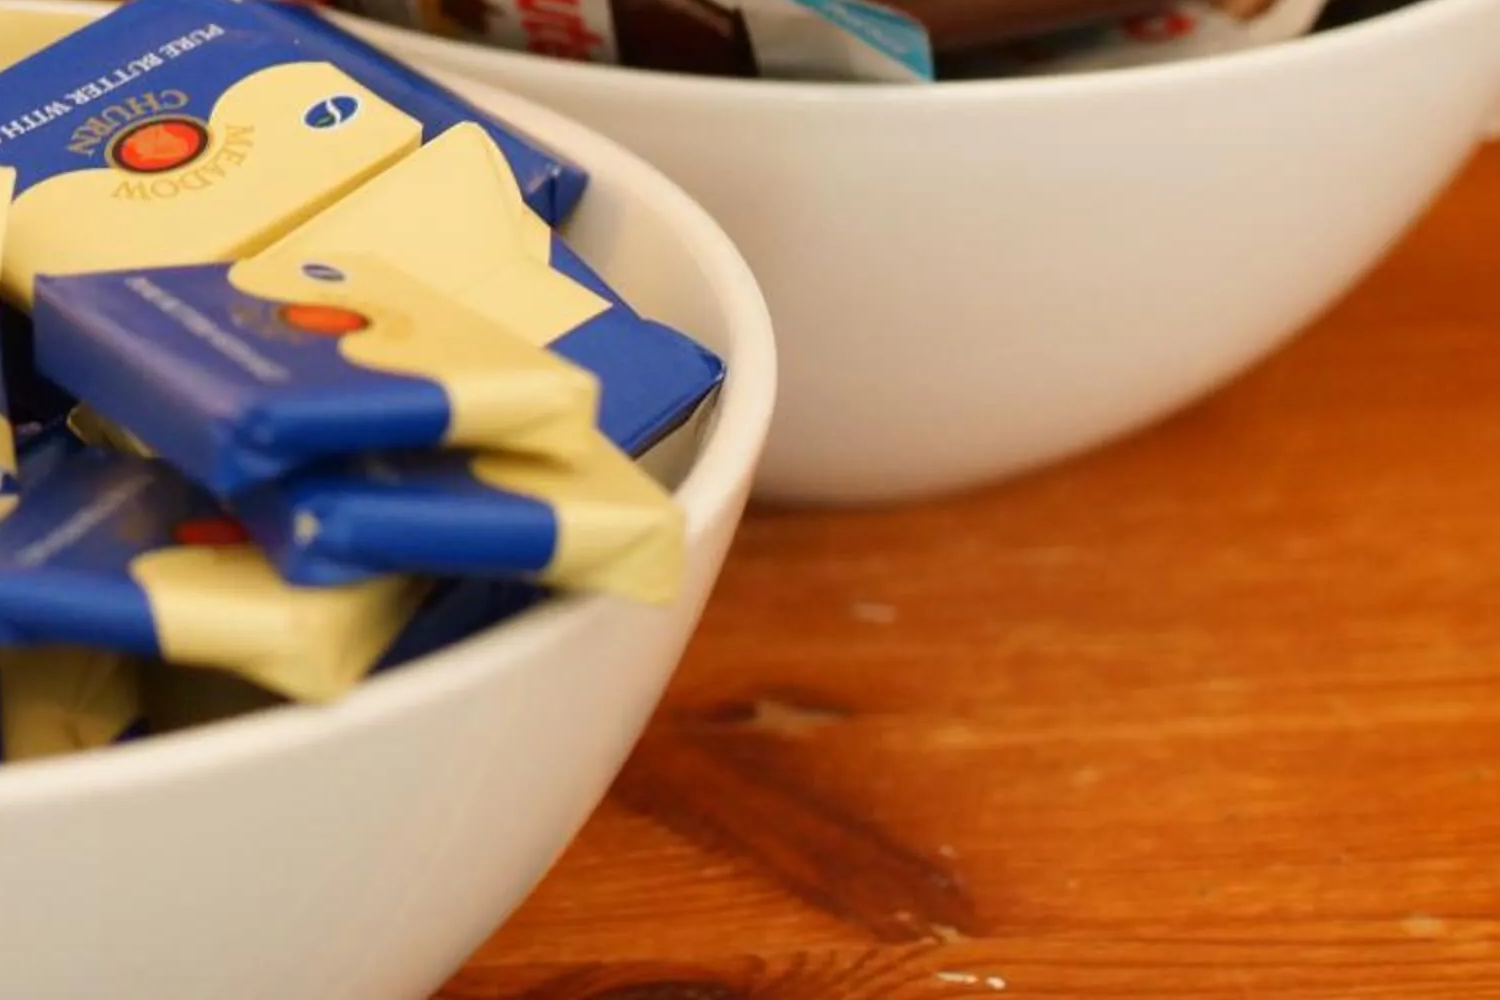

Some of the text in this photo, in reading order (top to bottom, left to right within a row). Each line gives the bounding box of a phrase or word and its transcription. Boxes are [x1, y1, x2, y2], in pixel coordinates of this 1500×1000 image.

[160, 23, 225, 59] PURE
[65, 53, 164, 105] BUTTER
[0, 102, 72, 139] WITH
[67, 89, 189, 159] CHURN
[111, 123, 255, 201] MEADOW
